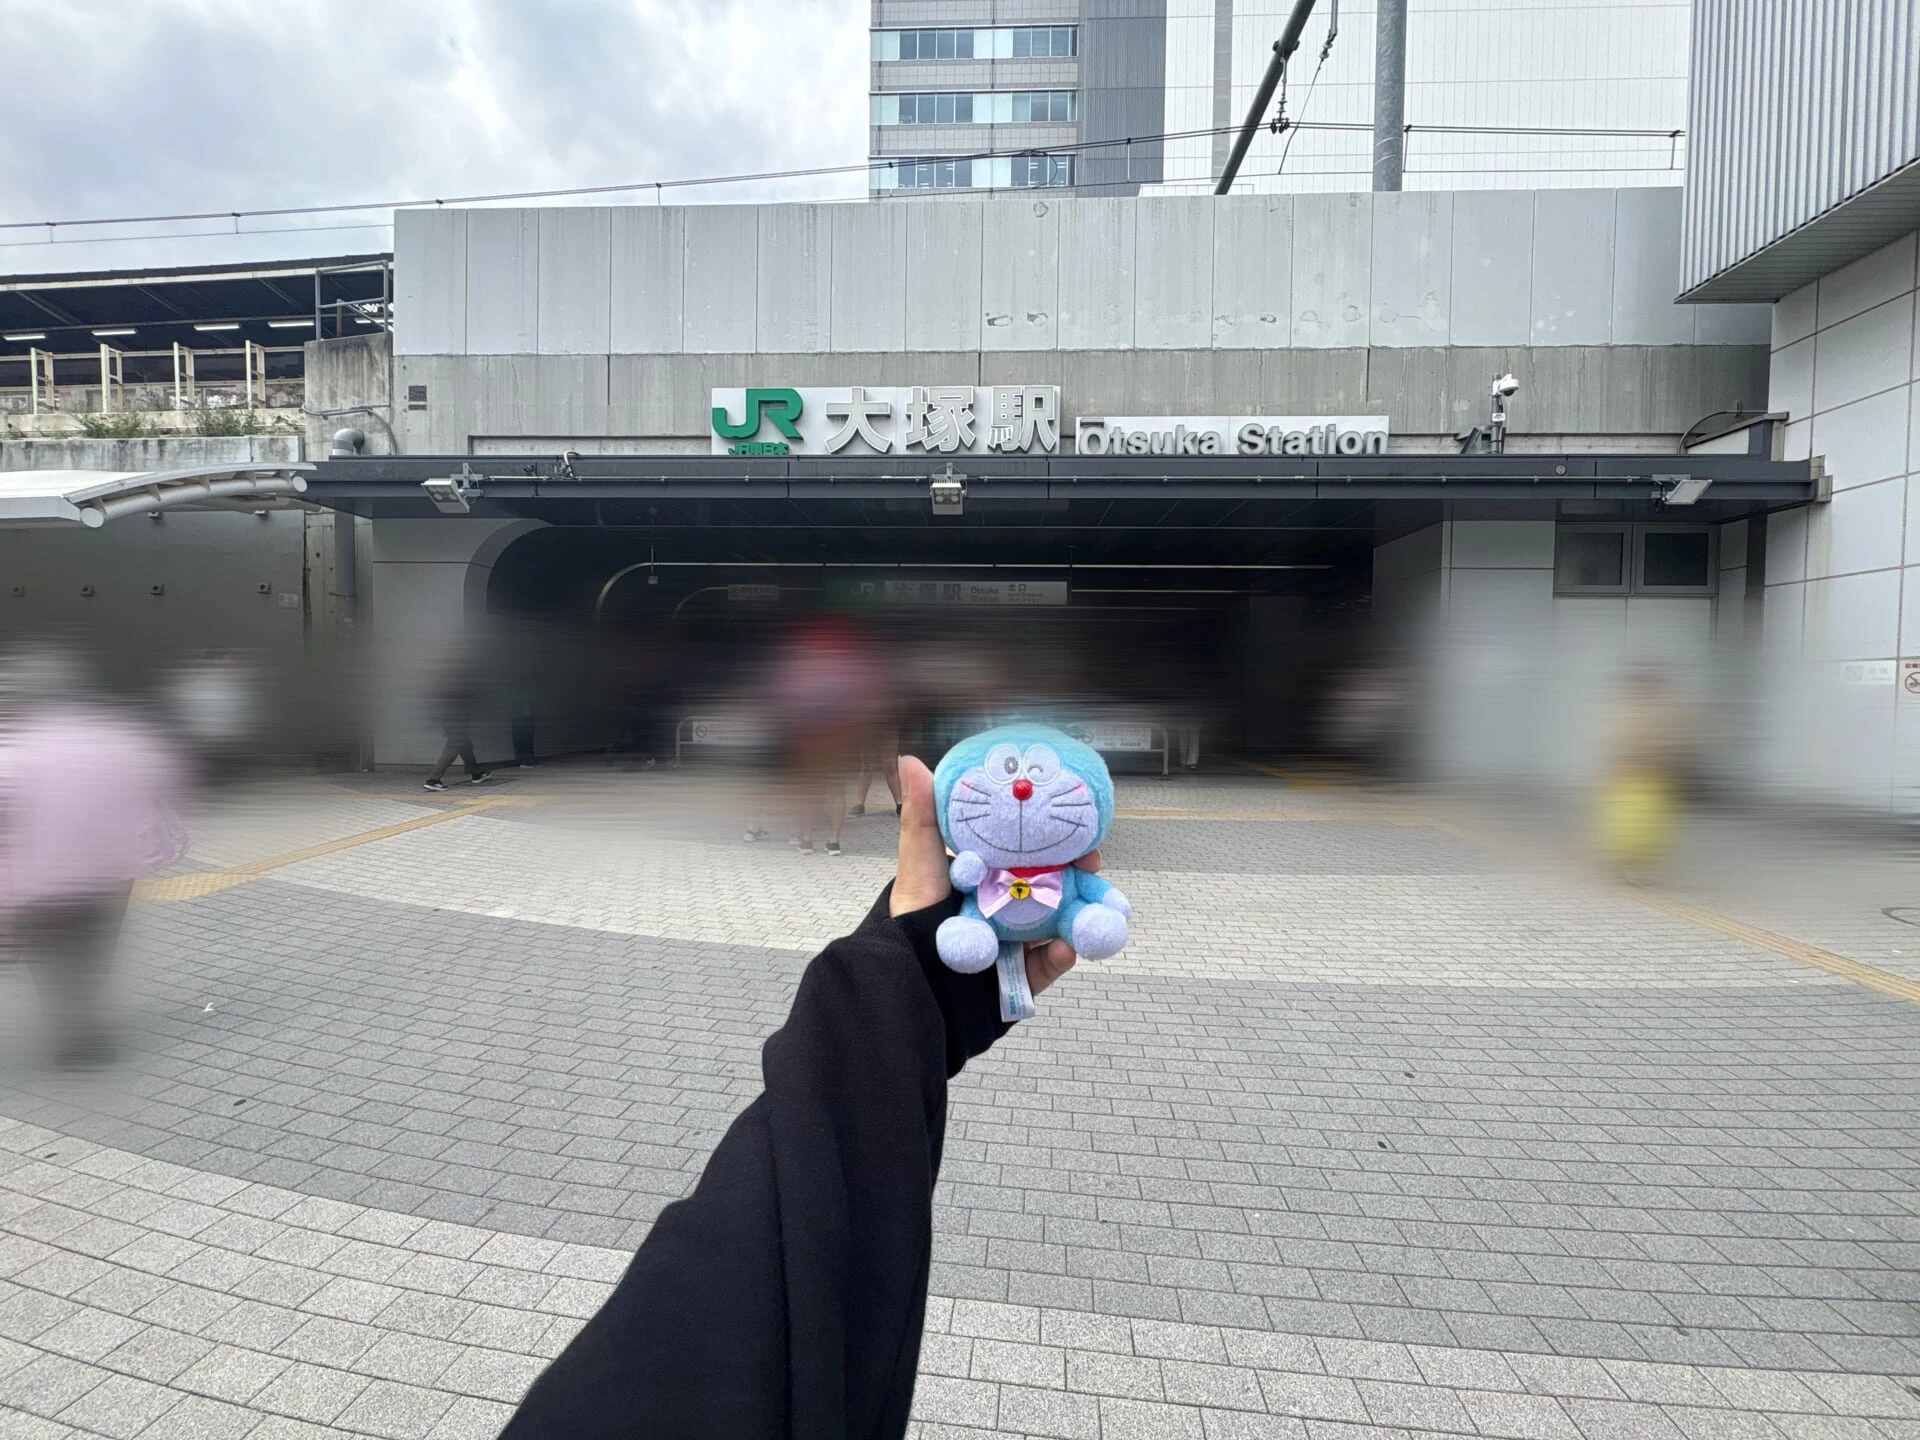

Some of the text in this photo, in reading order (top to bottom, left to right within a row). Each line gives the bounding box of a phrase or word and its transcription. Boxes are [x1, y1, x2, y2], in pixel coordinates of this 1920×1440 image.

[711, 388, 804, 441] JR
[825, 386, 1057, 455] 大塚駅
[1237, 422, 1388, 455] Station
